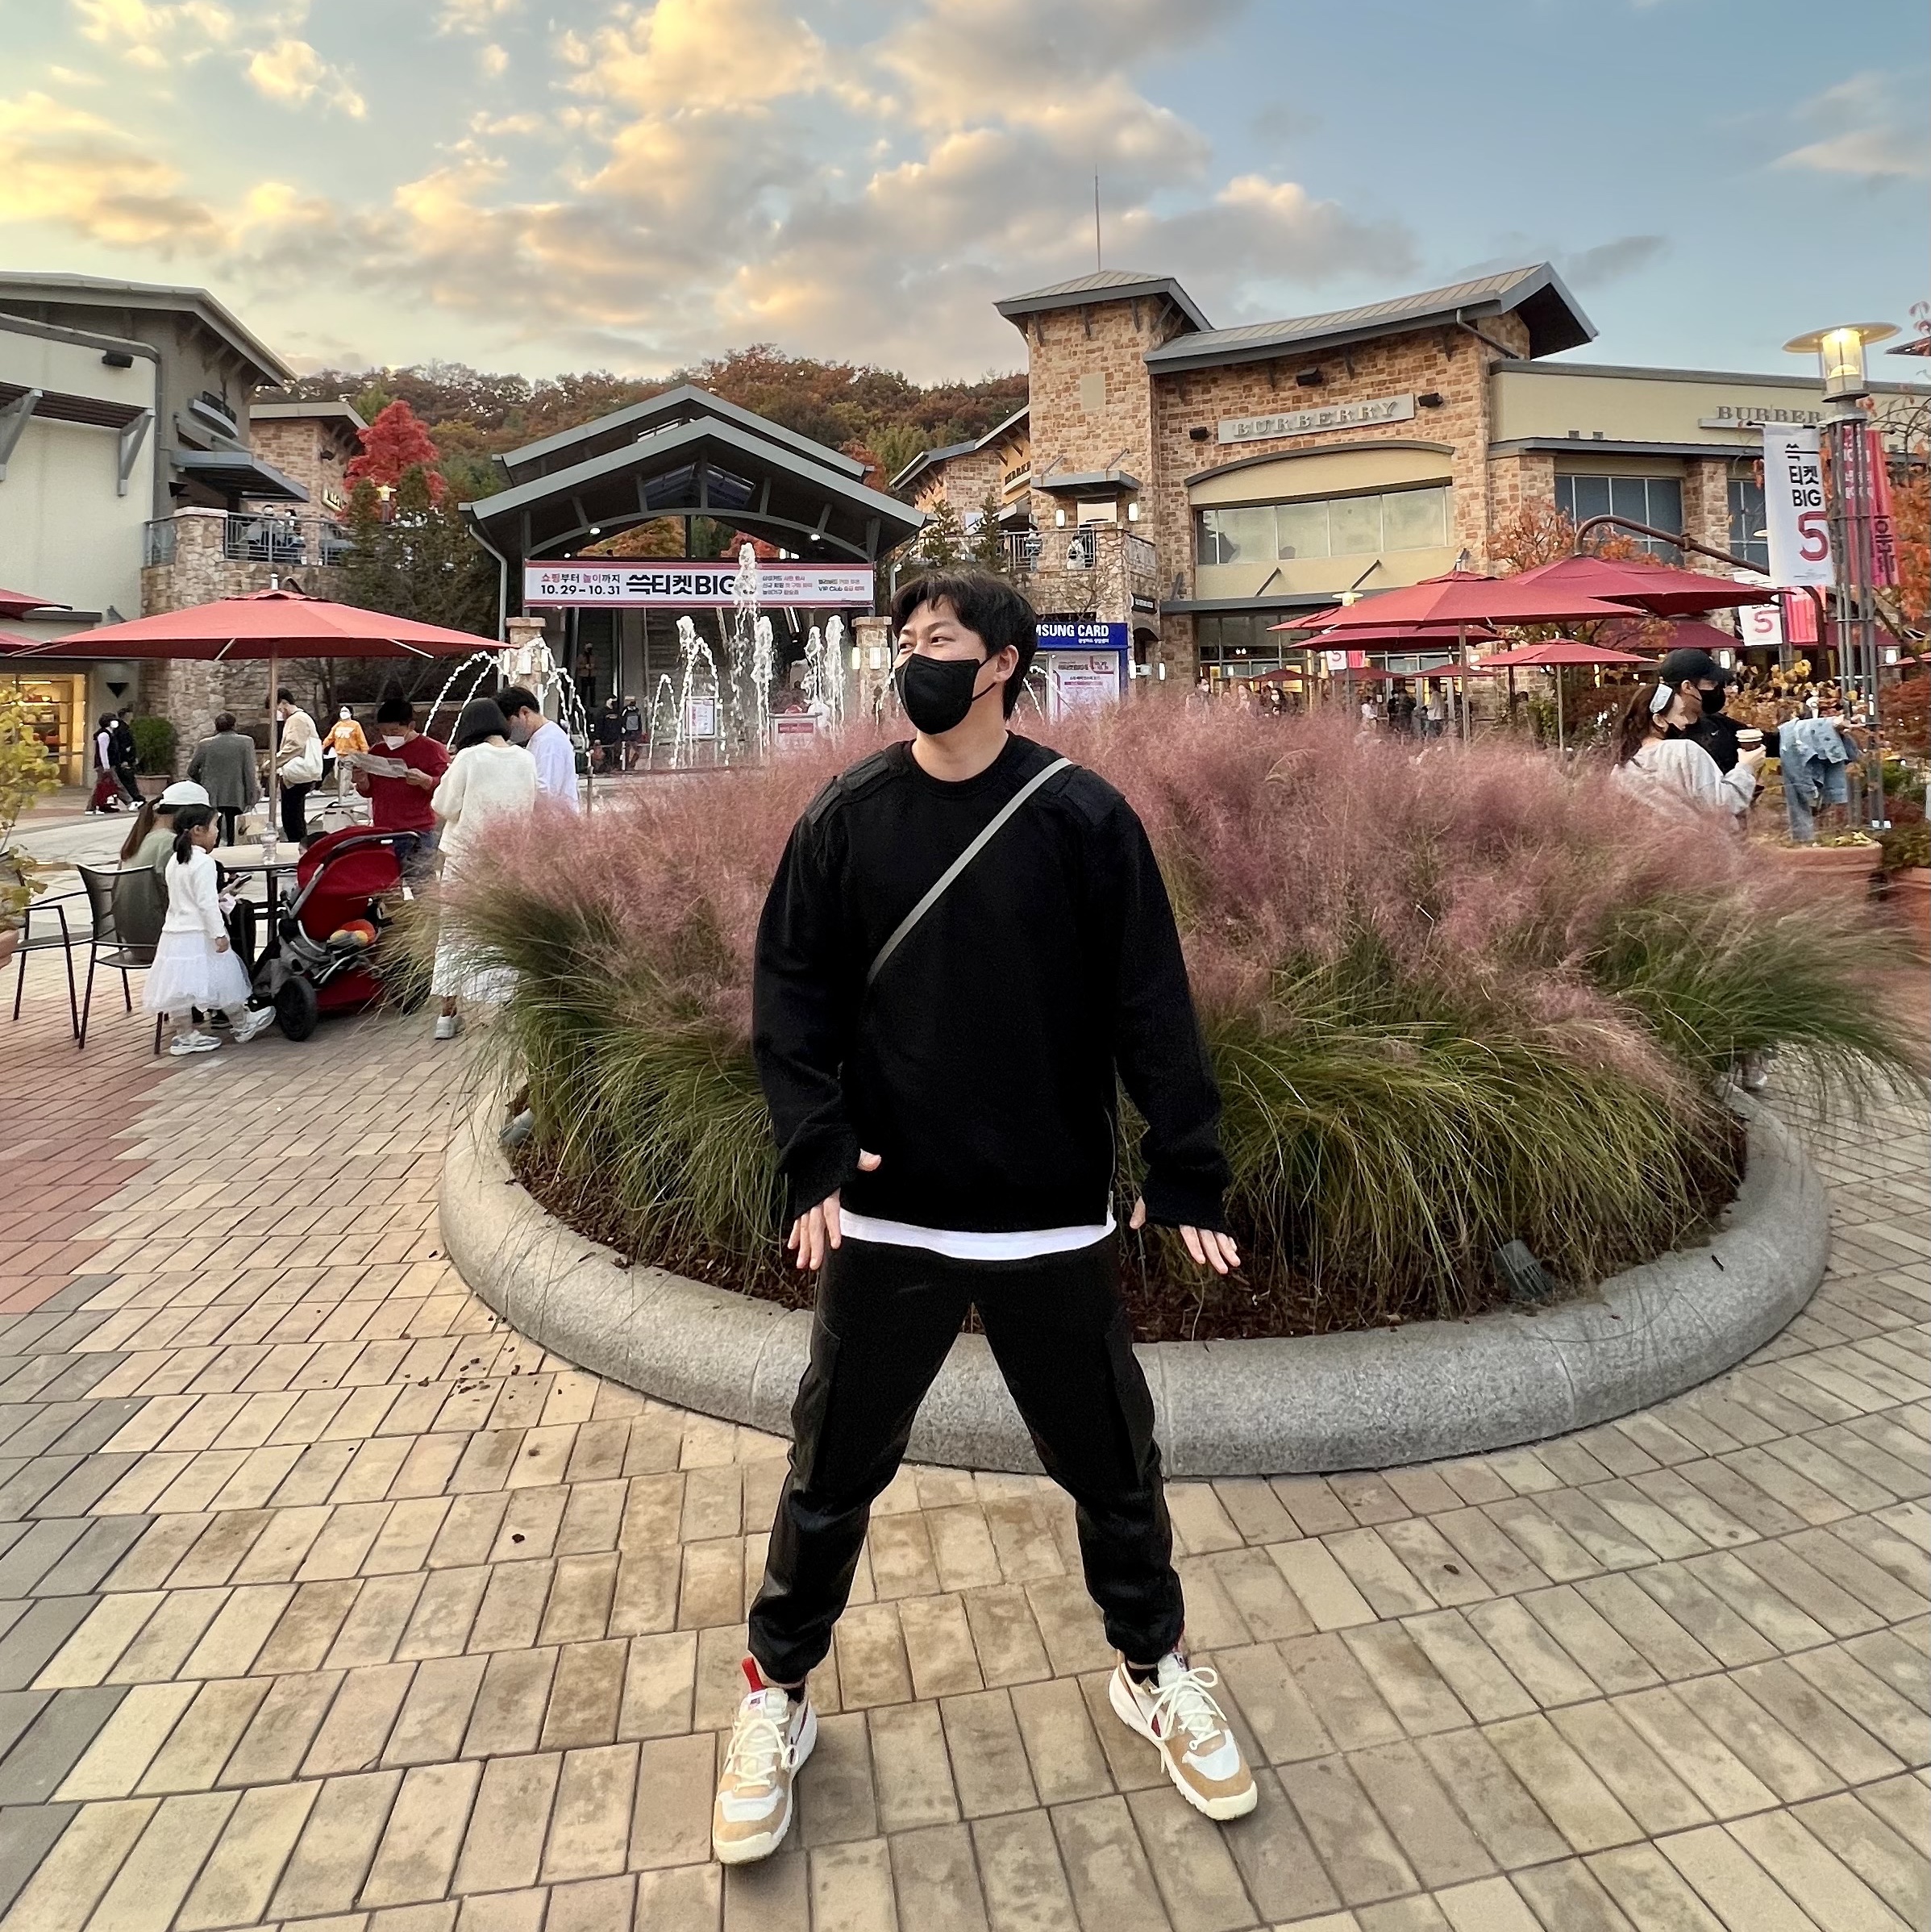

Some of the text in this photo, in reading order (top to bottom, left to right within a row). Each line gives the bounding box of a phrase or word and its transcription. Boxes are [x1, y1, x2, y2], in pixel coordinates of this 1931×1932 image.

[1232, 401, 1398, 438] BURBERRY
[1716, 406, 1824, 424] BURBER
[1788, 465, 1819, 485] 티켓
[1792, 489, 1821, 507] BIG
[1798, 510, 1829, 561] 5
[541, 573, 621, 583] 쇼핑부터 놀이까지
[1077, 624, 1109, 637] CARD
[1754, 610, 1780, 634] 5
